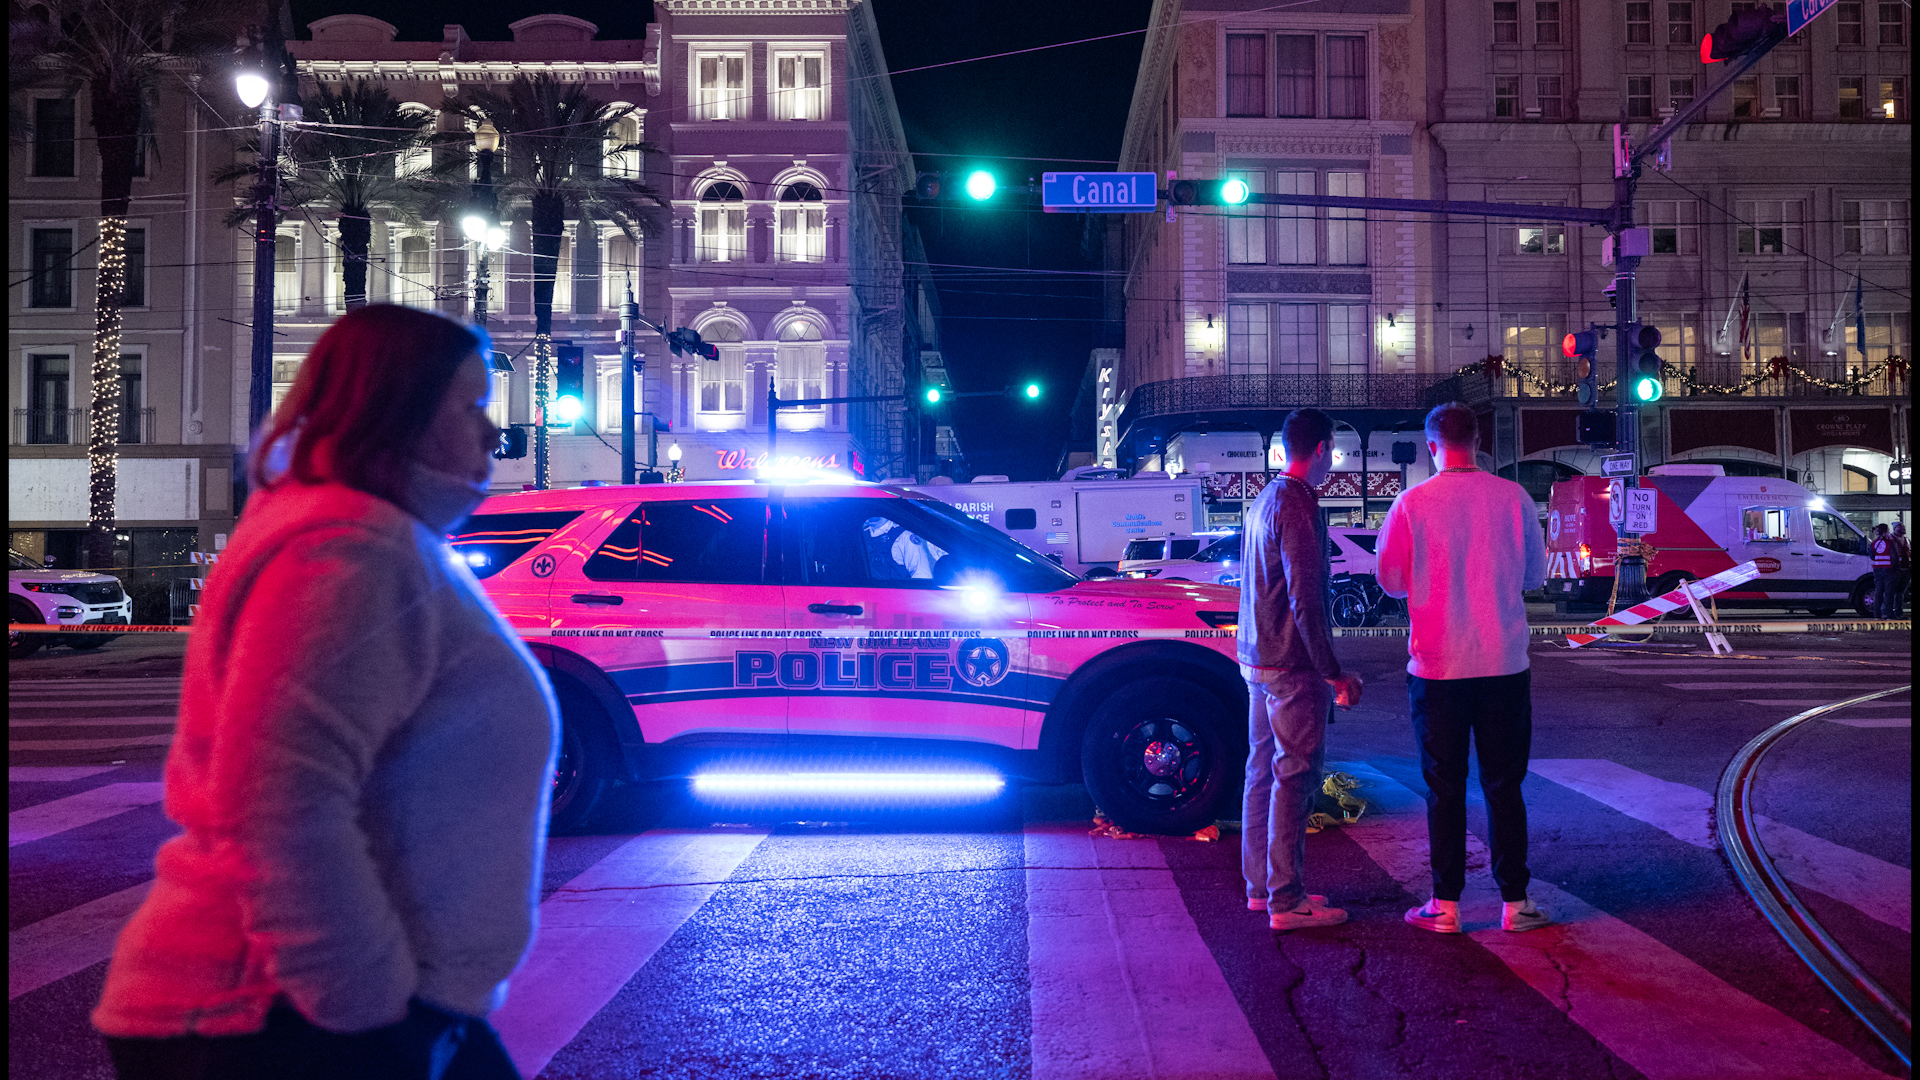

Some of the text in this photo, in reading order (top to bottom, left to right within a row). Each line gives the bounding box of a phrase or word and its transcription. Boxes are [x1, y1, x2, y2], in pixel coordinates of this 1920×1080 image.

[1073, 175, 1136, 204] Canal
[1226, 450, 1257, 458] CHOCOLATES
[1352, 450, 1361, 458] ICE
[716, 448, 840, 470] Walreens
[1610, 460, 1630, 470] ONE WAY
[1634, 493, 1649, 502] NO
[955, 502, 994, 512] PARISH
[1632, 503, 1651, 511] TURN
[1068, 597, 1104, 607] Protect
[1107, 600, 1126, 608] and
[1129, 600, 1142, 608] To
[551, 629, 664, 637] POLICE LINE DO NOT CROSS
[1027, 630, 1139, 638] POLICE LINE DO NOT CROSS
[1185, 630, 1233, 638] POLICE LINE
[809, 638, 951, 650] NEW ORLEANS
[736, 650, 952, 690] POLICE
